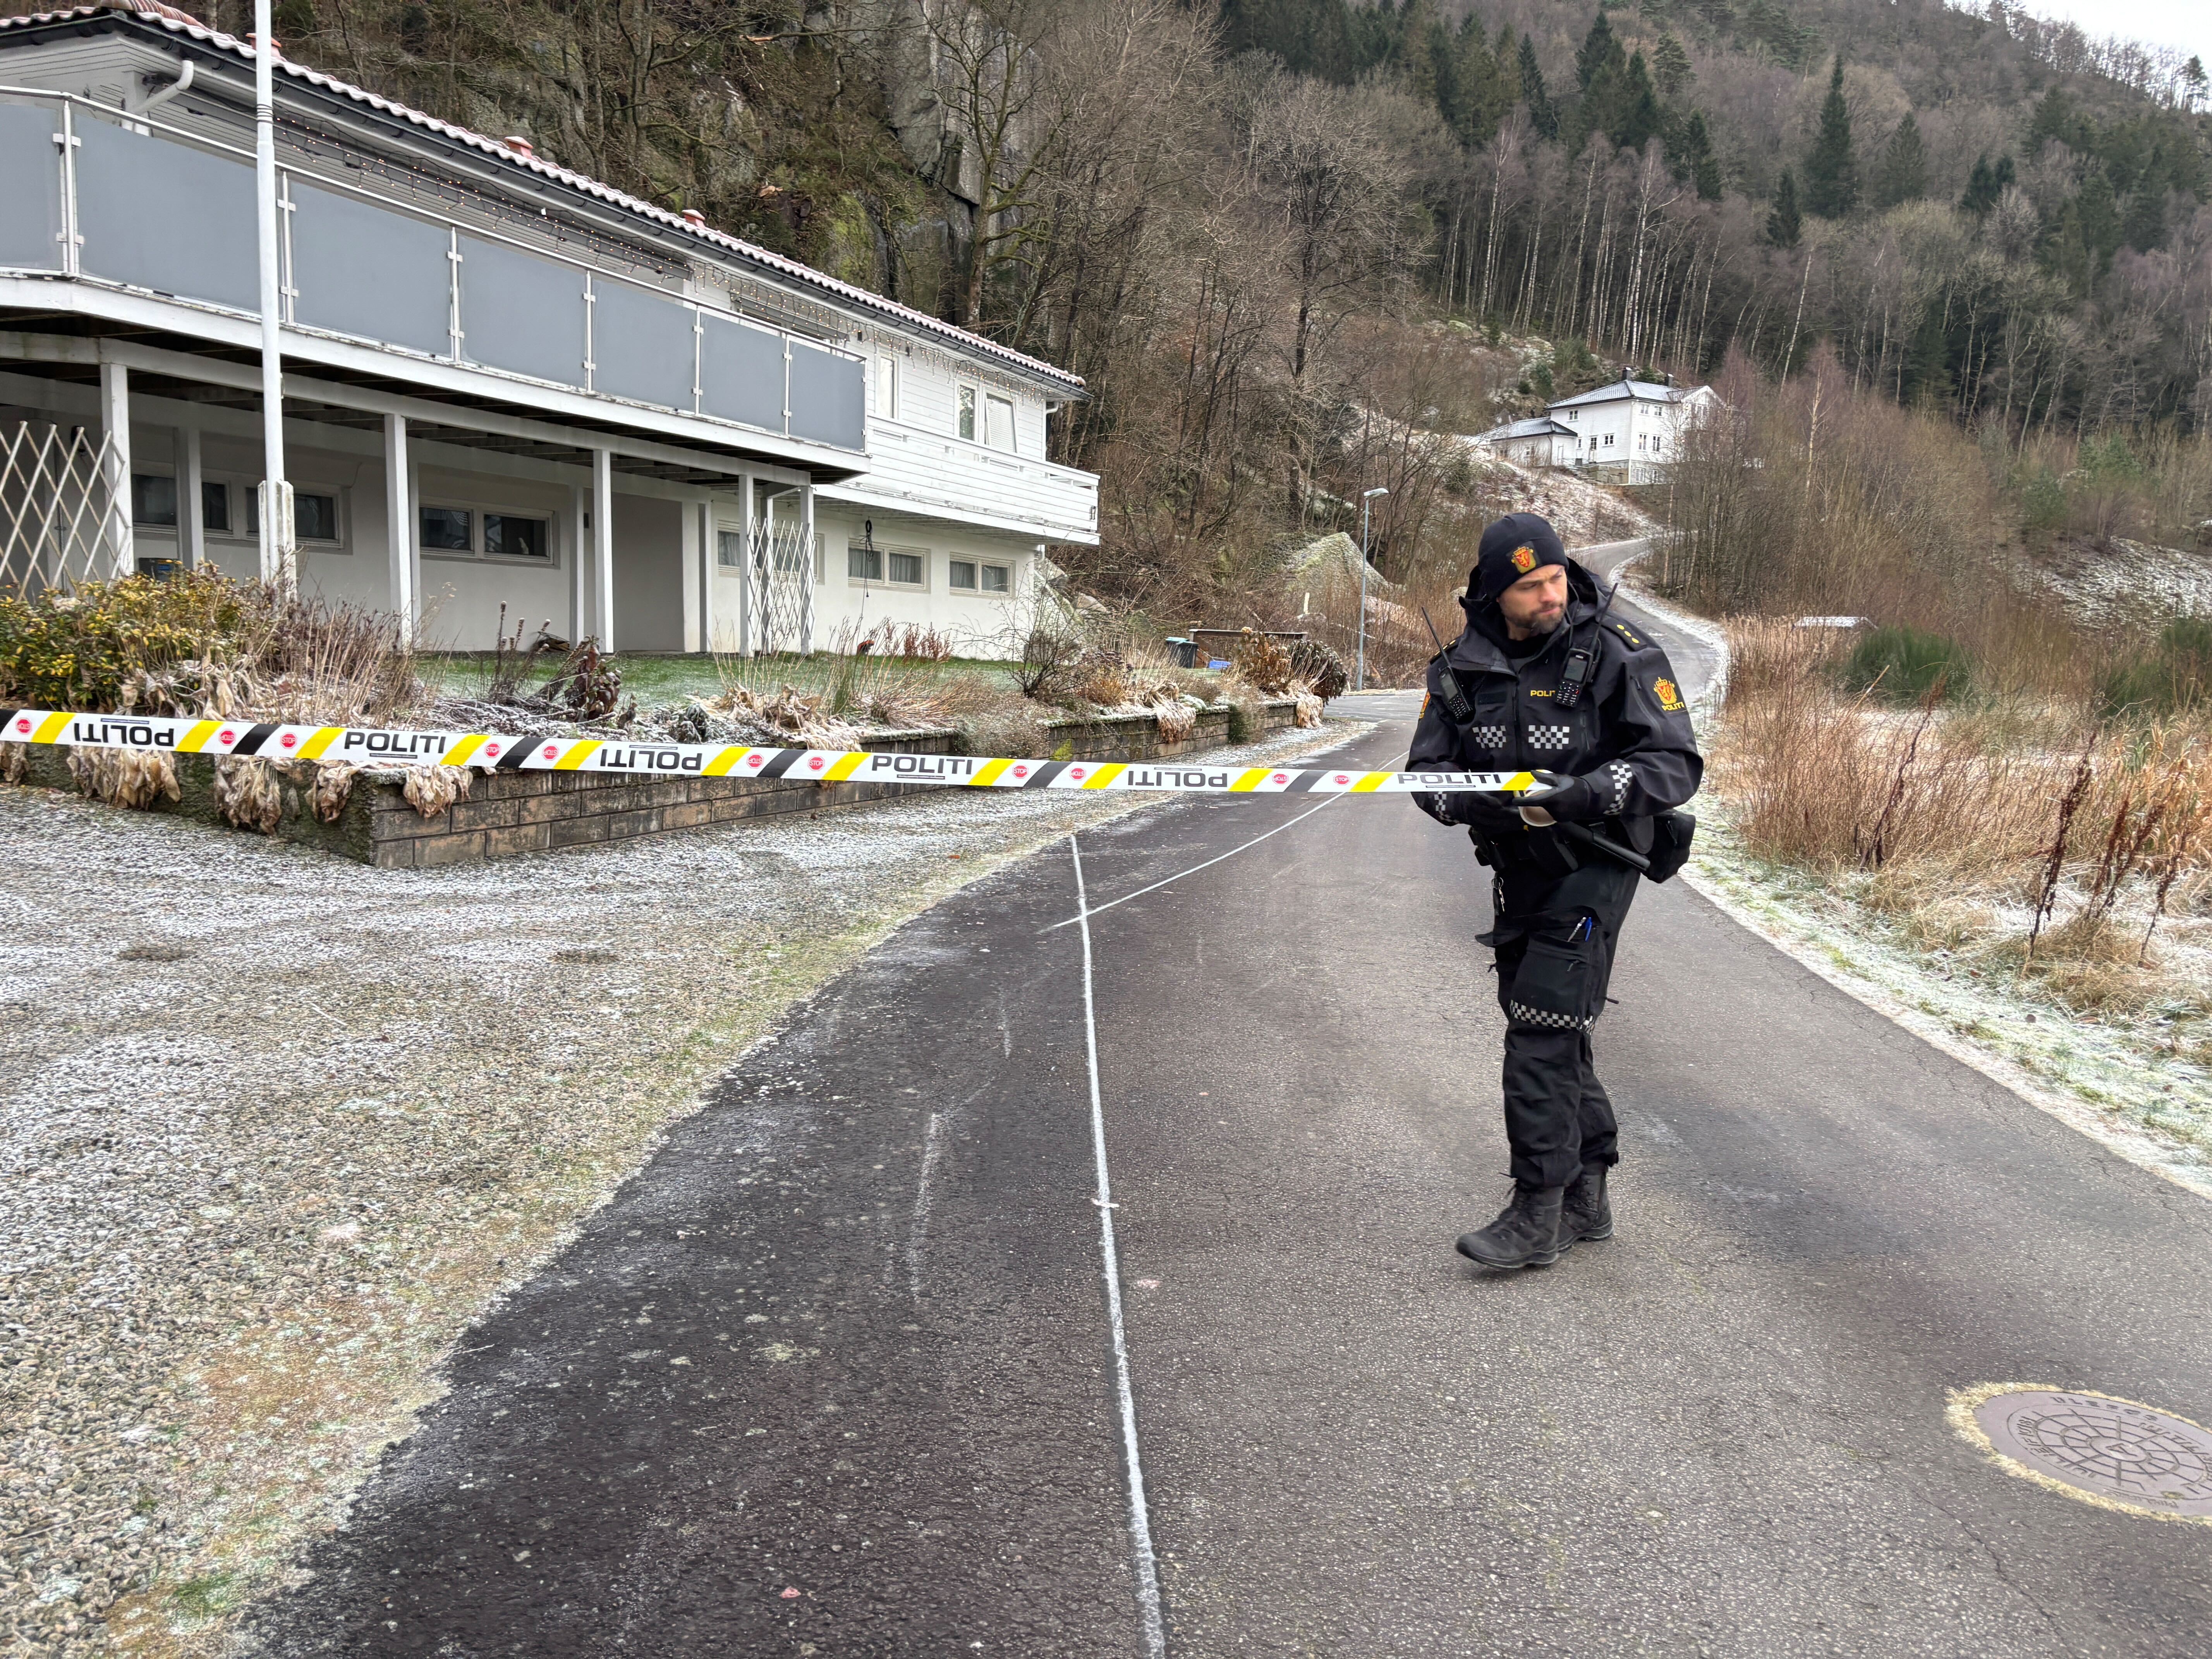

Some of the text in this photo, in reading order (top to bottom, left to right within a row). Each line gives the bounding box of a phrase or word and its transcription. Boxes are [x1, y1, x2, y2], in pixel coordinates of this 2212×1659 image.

[1662, 702, 1685, 711] POLITI
[74, 723, 174, 747] POLITI
[344, 732, 446, 754] POLITI
[600, 749, 702, 770] POLITI
[872, 756, 972, 775] POLITI
[1128, 771, 1227, 787] POLITI
[1397, 774, 1501, 784] POLITI
[2050, 1397, 2158, 1421] ULEFOS
